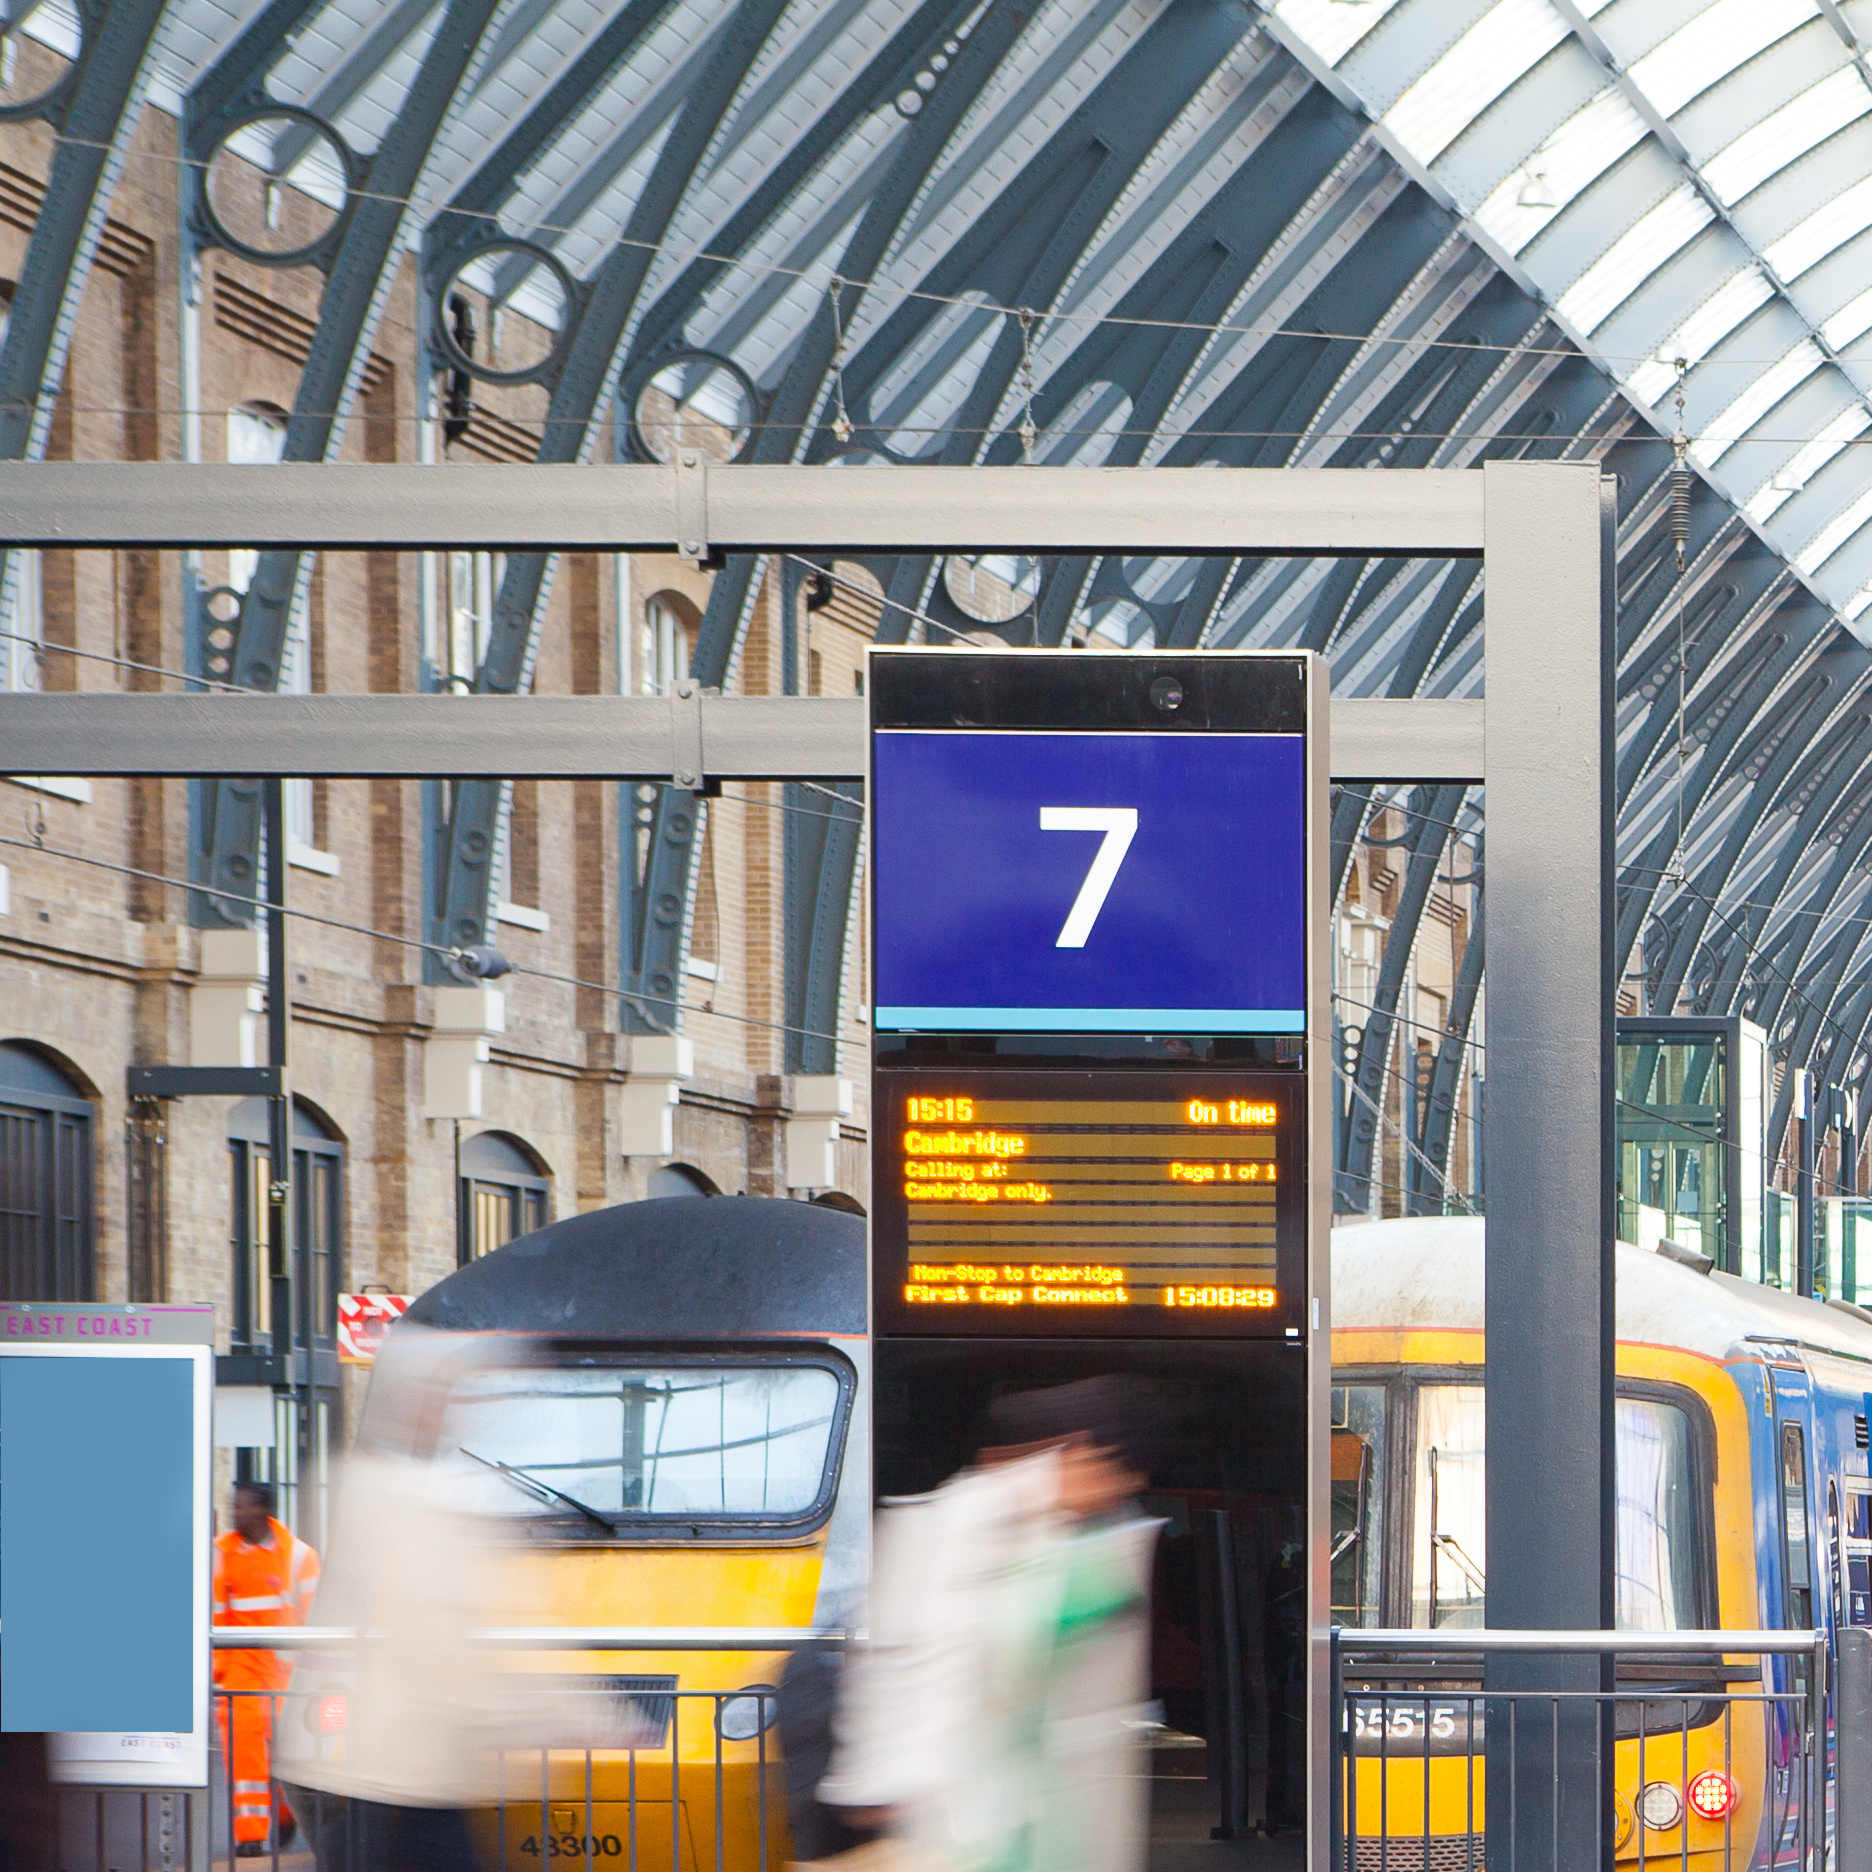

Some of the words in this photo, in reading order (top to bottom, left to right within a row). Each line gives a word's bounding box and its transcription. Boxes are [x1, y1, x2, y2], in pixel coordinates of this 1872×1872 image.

[1040, 807, 1138, 948] 7
[908, 1099, 973, 1121] 15:15
[1190, 1101, 1218, 1123] On
[1229, 1102, 1276, 1123] time
[904, 1131, 1024, 1157] Cambridge
[905, 1161, 975, 1181] Calling
[981, 1162, 1007, 1178] at:
[1171, 1163, 1214, 1182] Page
[1222, 1164, 1231, 1179] 1
[1238, 1164, 1258, 1179] of
[1267, 1164, 1276, 1179] 1
[905, 1182, 998, 1201] Cambridge
[1005, 1182, 1052, 1202] only.
[914, 1265, 998, 1283] Non-Stop
[1004, 1265, 1024, 1281] to
[1031, 1265, 1123, 1285] Cambridge
[905, 1285, 969, 1302] First
[980, 1285, 1023, 1304] Cap
[1033, 1286, 1128, 1302] Connect
[1165, 1287, 1275, 1307] 15:08:29
[6, 1316, 65, 1336] EAST
[76, 1316, 152, 1337] COAST
